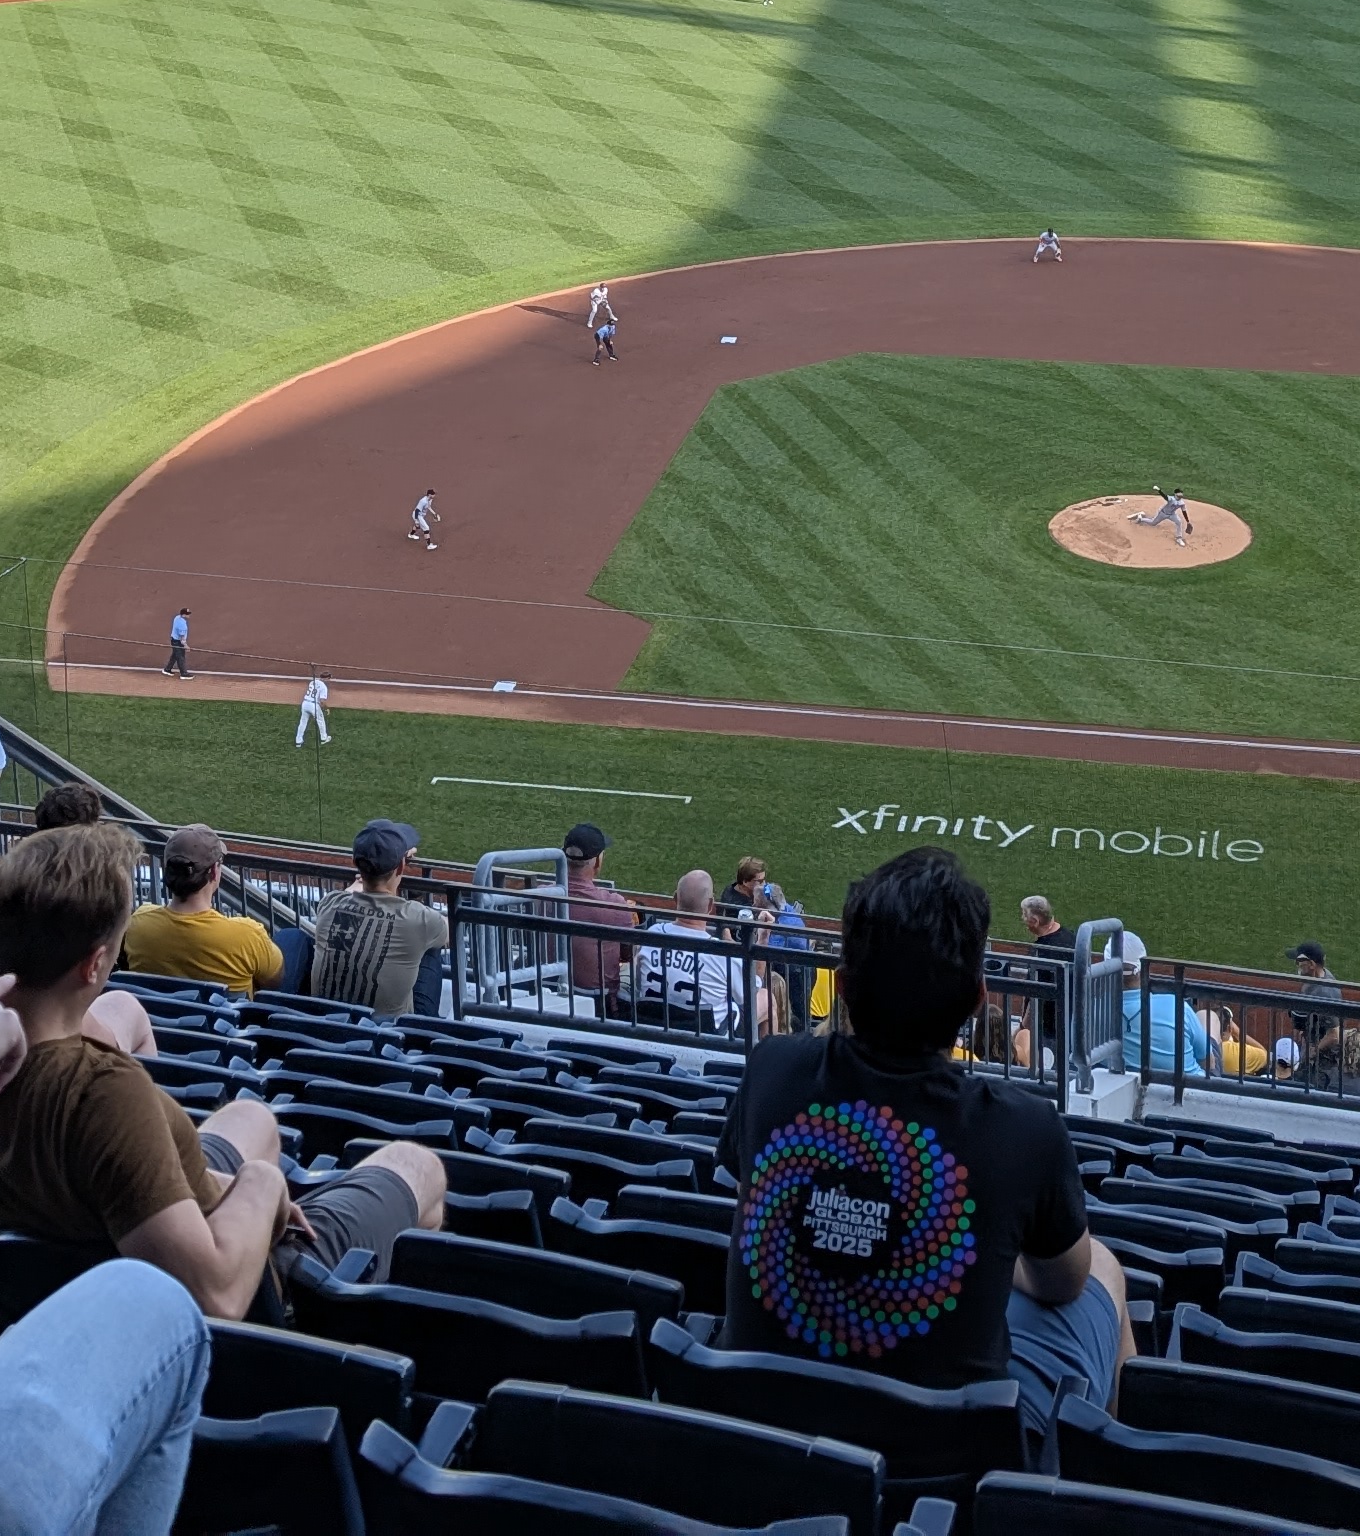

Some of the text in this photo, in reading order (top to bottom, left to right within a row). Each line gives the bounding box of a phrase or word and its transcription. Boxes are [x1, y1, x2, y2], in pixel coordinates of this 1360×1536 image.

[831, 804, 1265, 863] xfinity mobile
[650, 949, 705, 976] GBSON
[805, 1184, 890, 1219] juliacon
[802, 1216, 888, 1241] PITTSBURGH
[814, 1207, 888, 1229] GLOBAL
[812, 1229, 873, 1258] 2025
